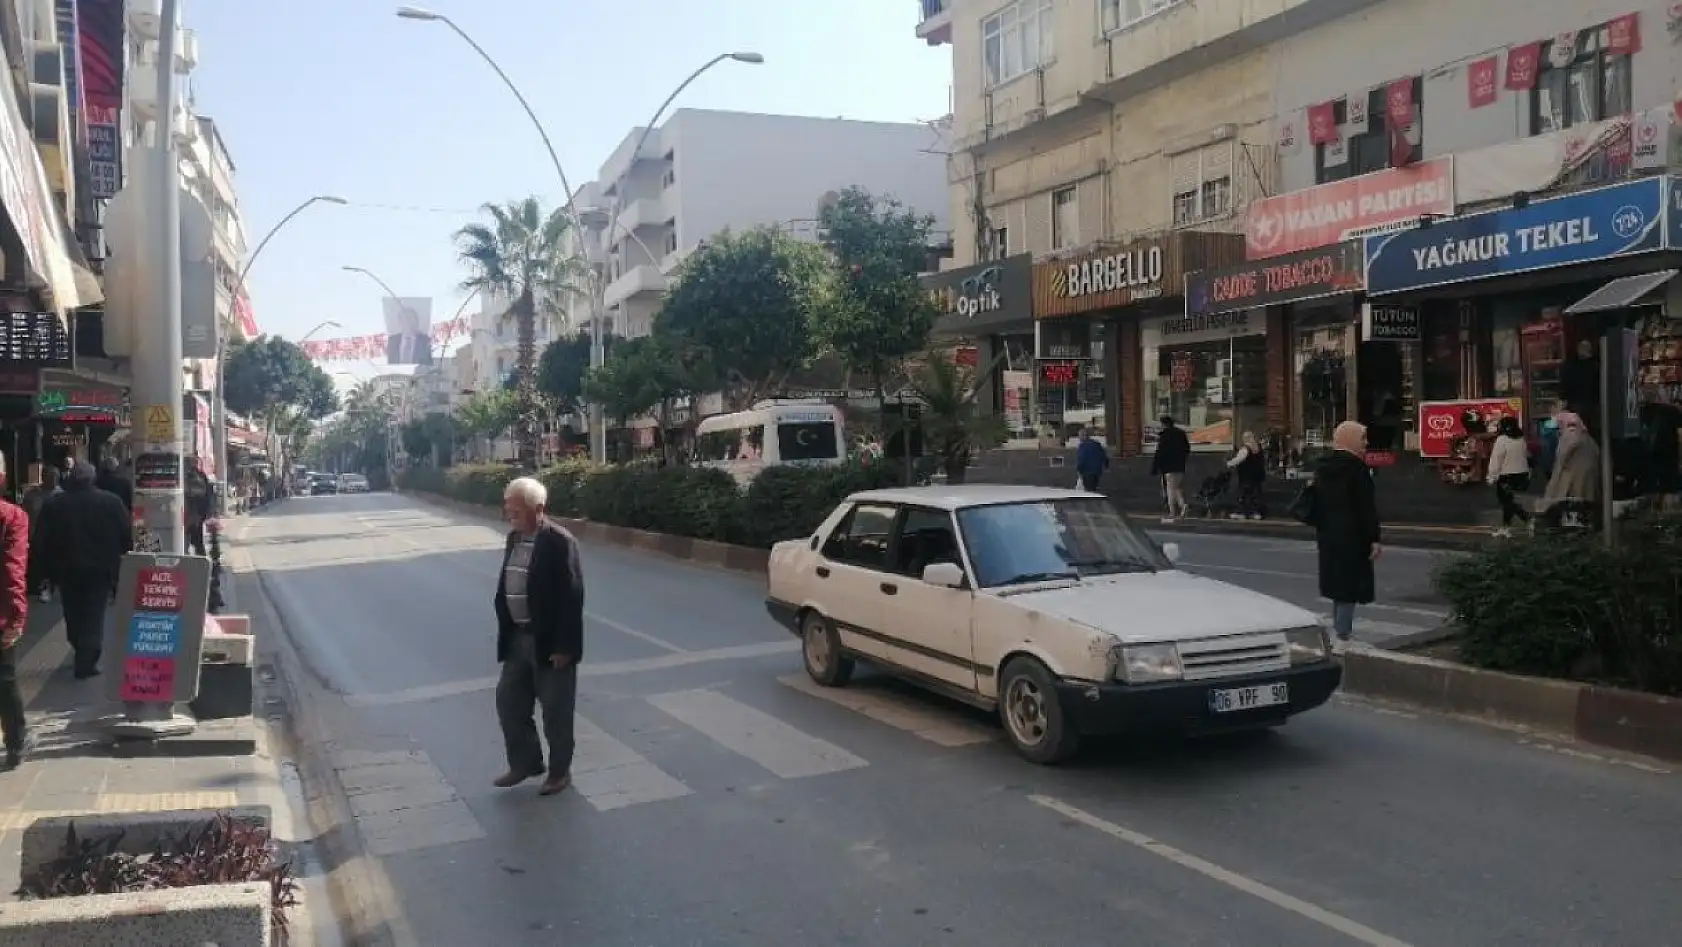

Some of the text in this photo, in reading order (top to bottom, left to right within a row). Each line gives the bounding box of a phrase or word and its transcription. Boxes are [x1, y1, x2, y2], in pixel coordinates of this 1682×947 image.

[1413, 216, 1599, 270] YAĞMUR TEKEL
[1068, 245, 1163, 297] BARGELLO
[1262, 255, 1333, 294] TOBACCO
[956, 289, 1001, 318] Optik
